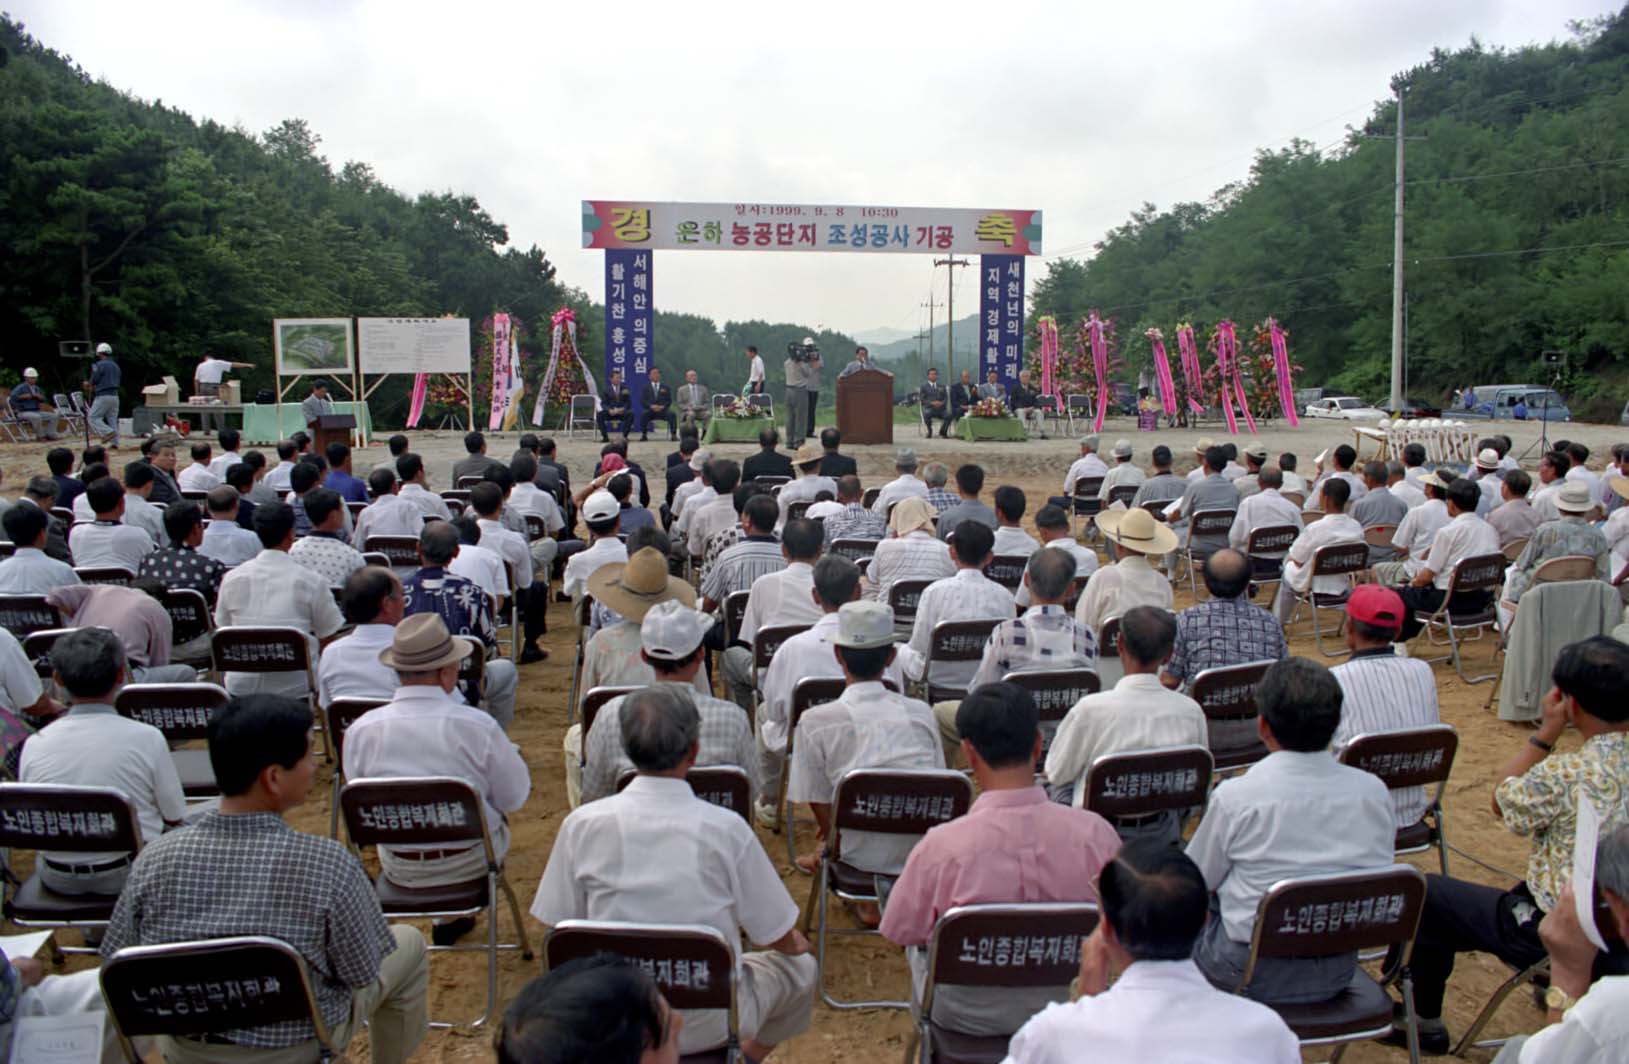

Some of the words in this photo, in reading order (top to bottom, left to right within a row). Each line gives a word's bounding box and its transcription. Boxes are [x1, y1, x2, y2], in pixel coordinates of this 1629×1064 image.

[610, 207, 652, 243] 경
[815, 206, 828, 217] 9.
[836, 206, 844, 217] 8
[860, 207, 898, 218] 10:30
[675, 220, 723, 245] 은하
[731, 221, 817, 247] 농공단지
[827, 223, 910, 249] 조성공사
[916, 225, 954, 250] 기공
[975, 212, 1017, 248] 축
[986, 309, 1000, 376] 경제활
[1102, 767, 1199, 798] 노인종합복지회관
[359, 801, 467, 830] 노인종합복지회관
[852, 793, 954, 820] 노인종합복지회관
[2, 809, 118, 838] 노인종합복지회관
[1279, 893, 1405, 934] 노인종합복지회관
